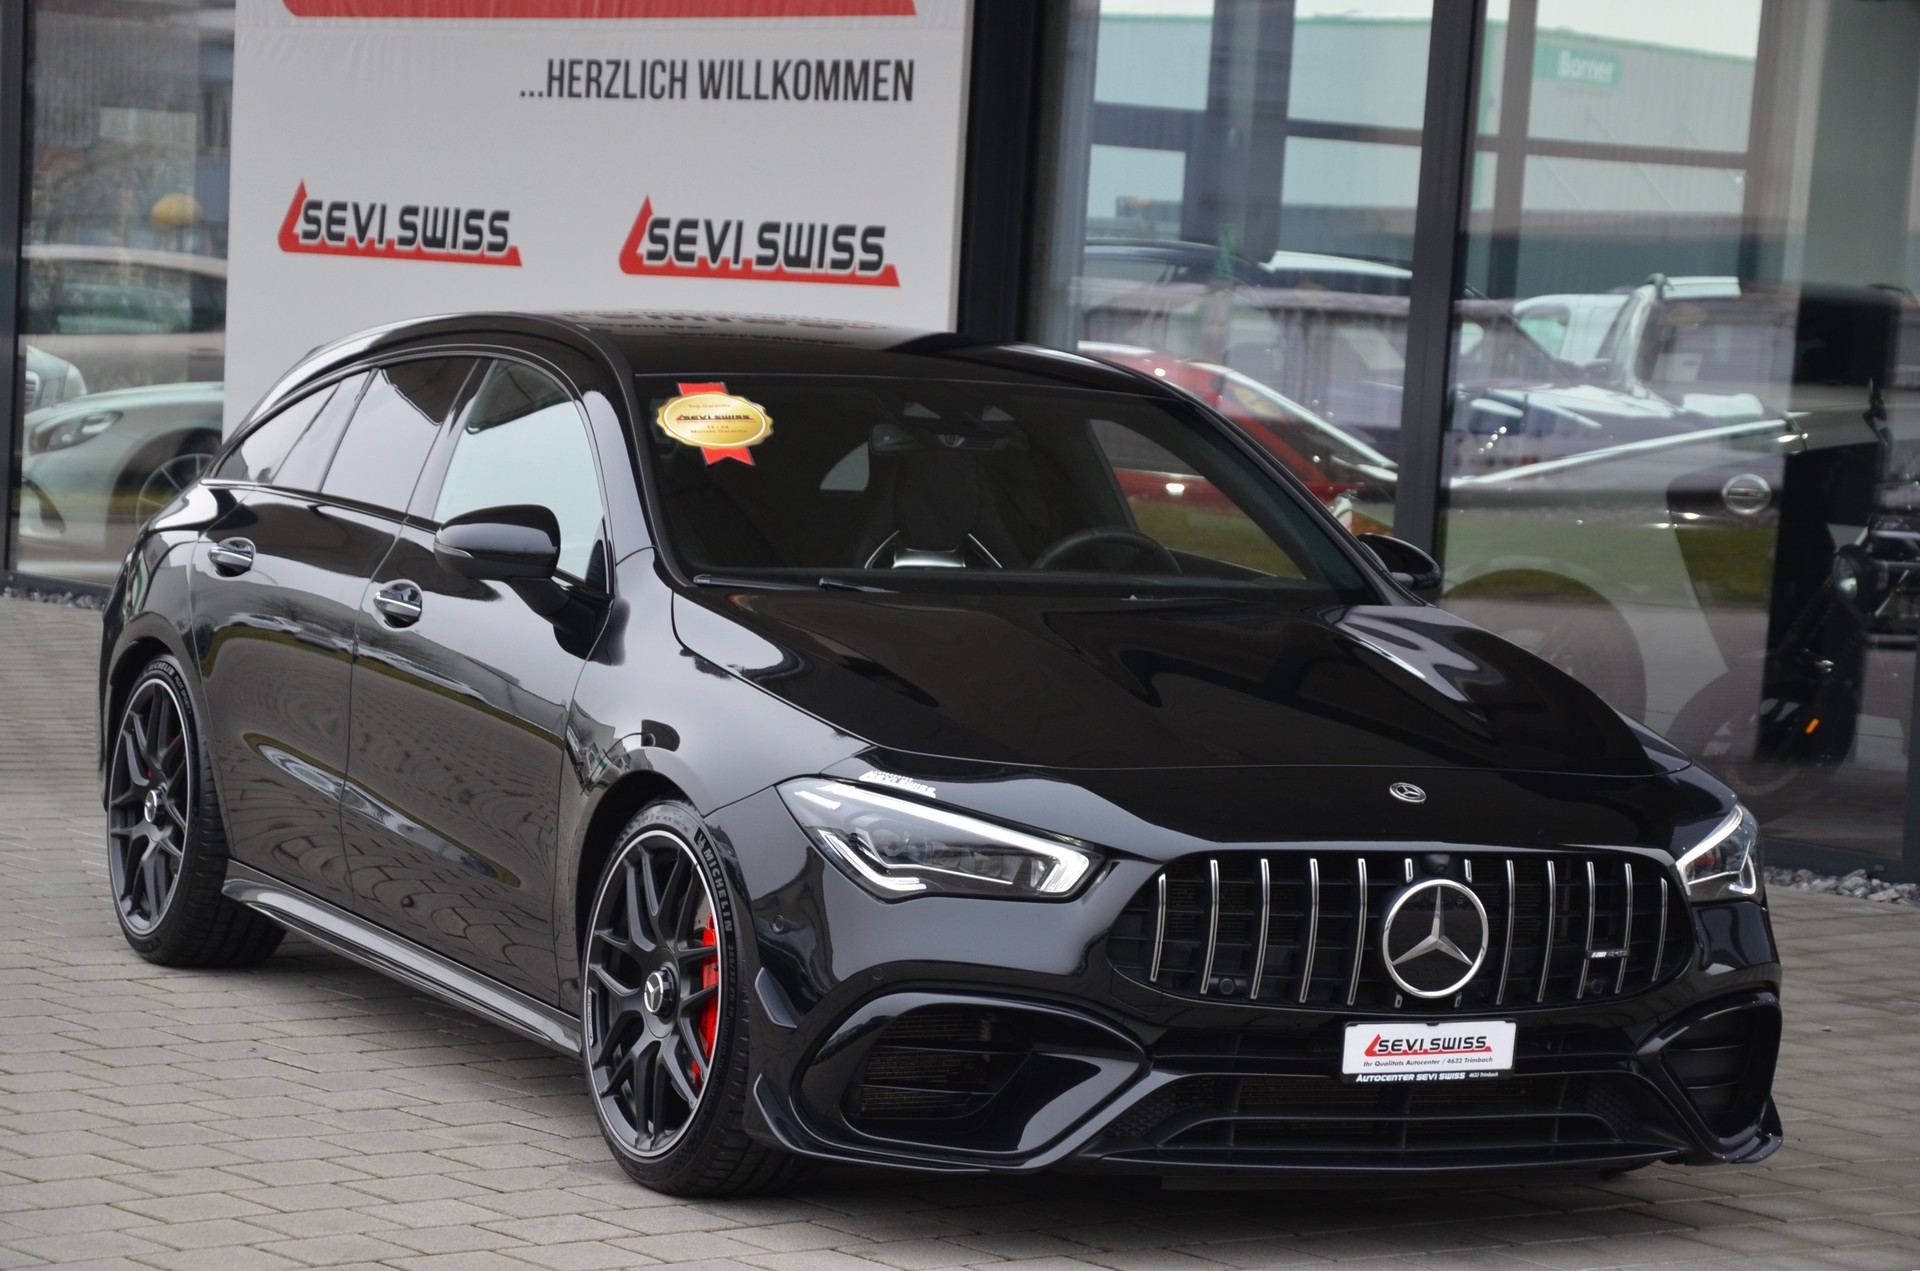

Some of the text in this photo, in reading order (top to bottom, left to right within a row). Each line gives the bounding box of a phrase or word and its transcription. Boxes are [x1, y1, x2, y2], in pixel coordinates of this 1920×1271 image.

[519, 57, 915, 102] ...HERZLICH WILLKOMMEN
[300, 199, 511, 254] SEVI SWISS
[645, 217, 887, 273] SEVI SWISS
[703, 847, 733, 932] MICHELIN
[1377, 1035, 1487, 1053] SEVI SWISS
[1416, 1073, 1438, 1081] SEVI
[1438, 1072, 1466, 1080] SWISS
